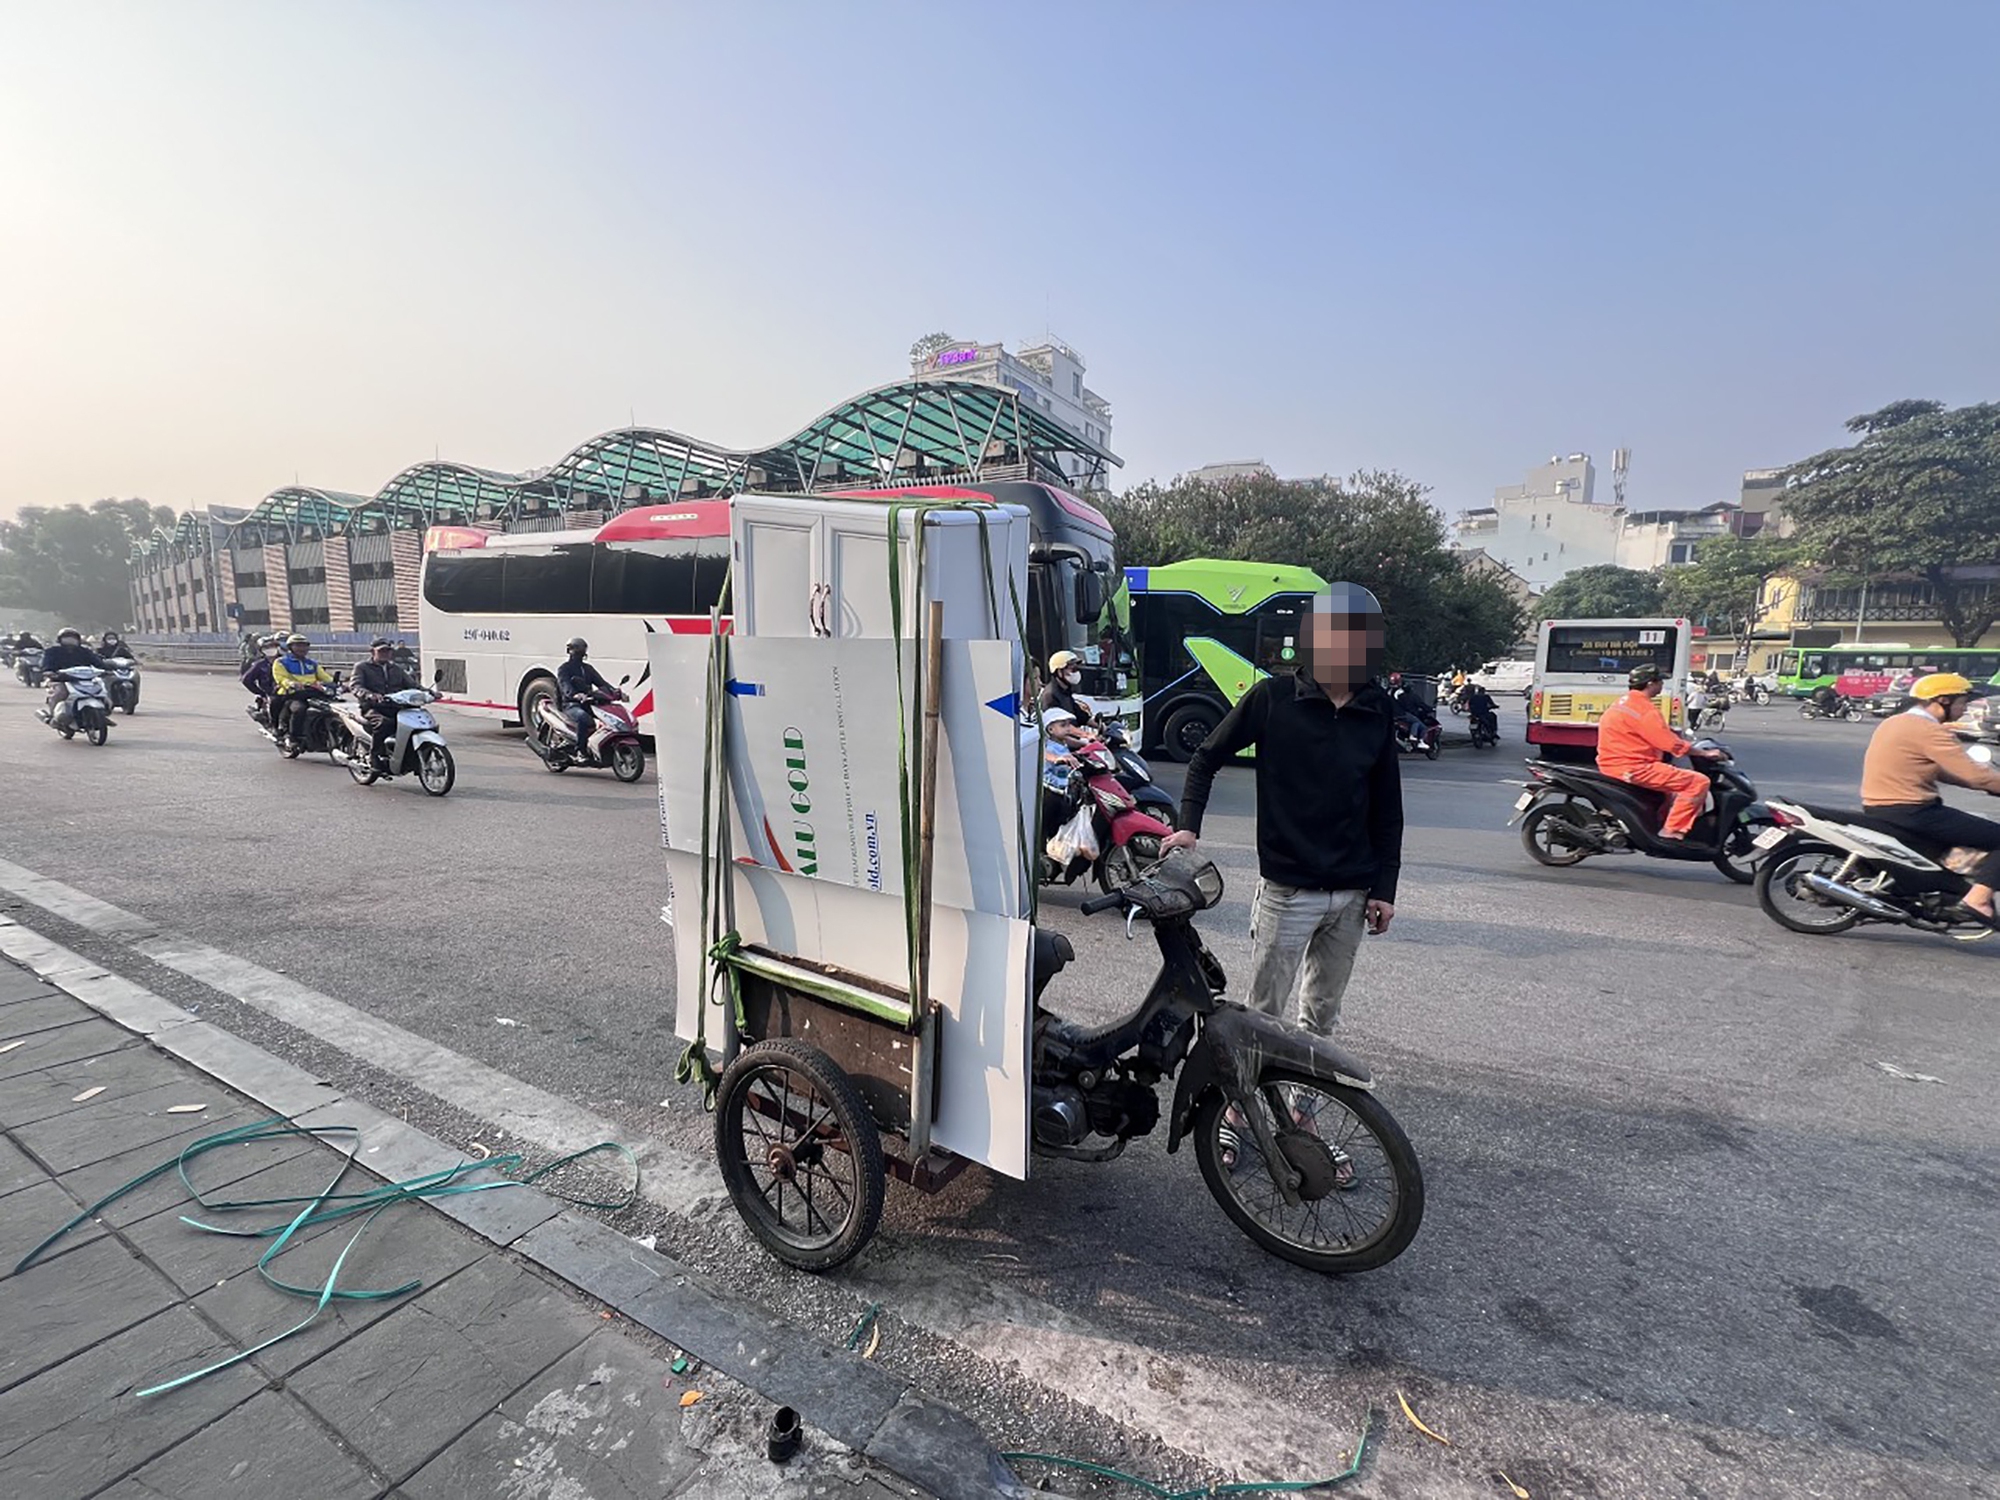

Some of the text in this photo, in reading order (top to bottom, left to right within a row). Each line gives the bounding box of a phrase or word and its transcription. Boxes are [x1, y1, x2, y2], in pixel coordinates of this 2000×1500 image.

[1645, 632, 1658, 642] 11
[783, 726, 818, 877] ALU GOLD
